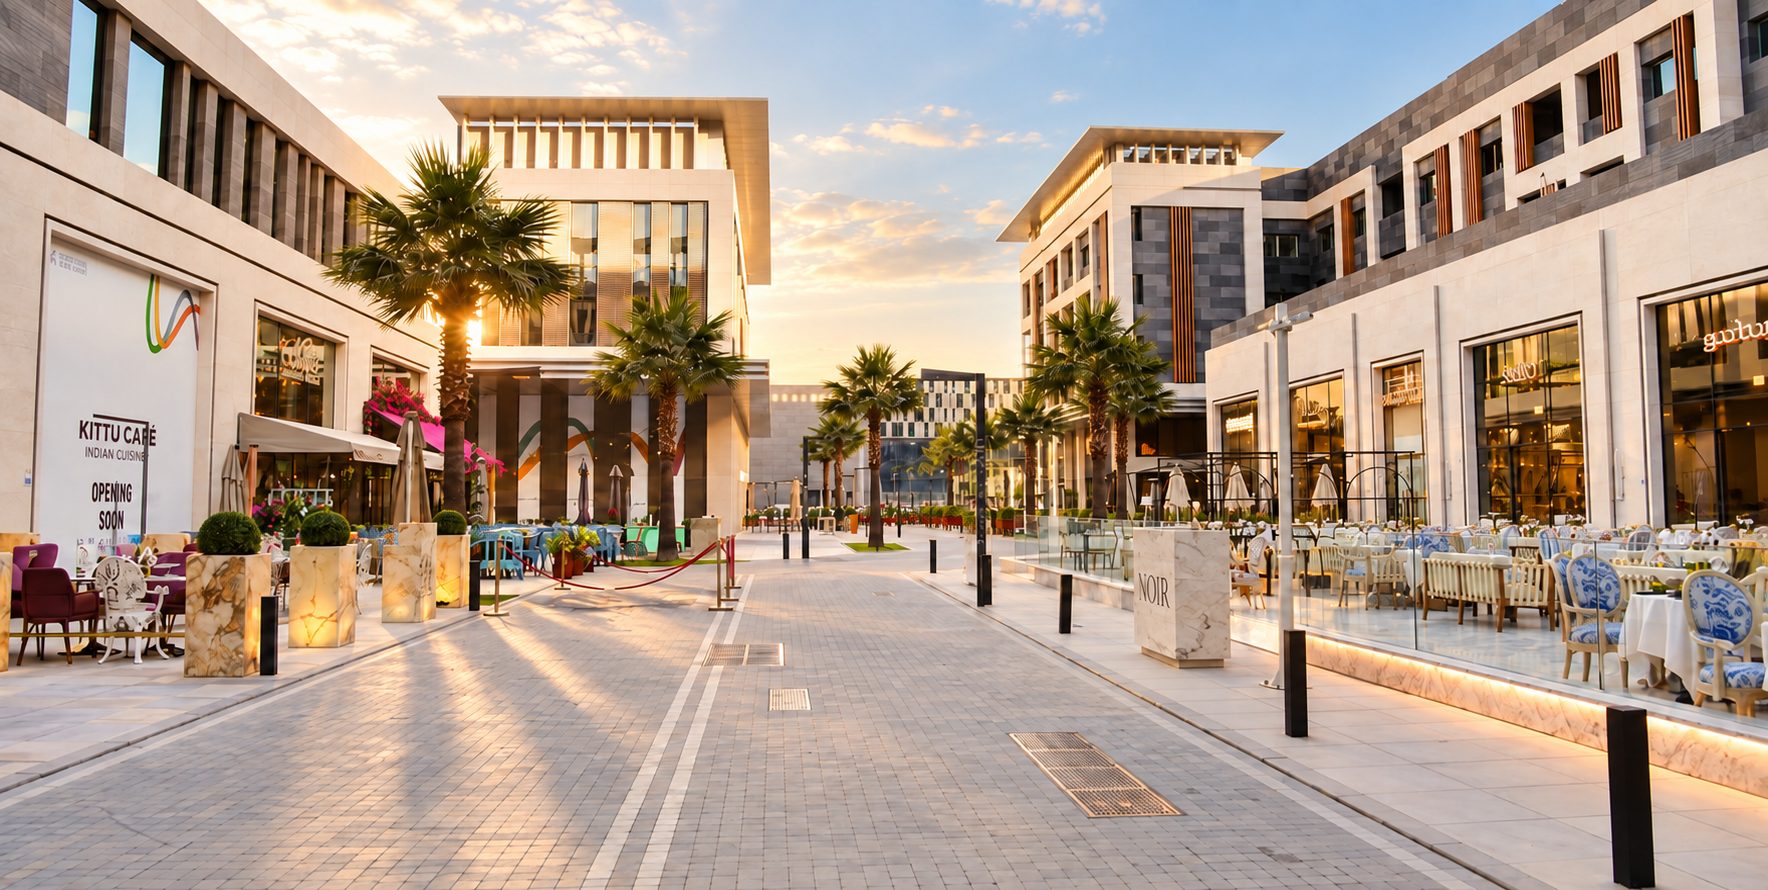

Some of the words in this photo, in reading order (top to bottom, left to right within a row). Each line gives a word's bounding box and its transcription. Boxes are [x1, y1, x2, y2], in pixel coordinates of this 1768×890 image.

[79, 419, 120, 442] KITTU
[123, 424, 157, 446] CAFÉ
[85, 446, 114, 459] INDIAN
[91, 481, 133, 503] OPENING
[98, 510, 124, 530] SOON
[1138, 572, 1170, 609] NOIR
